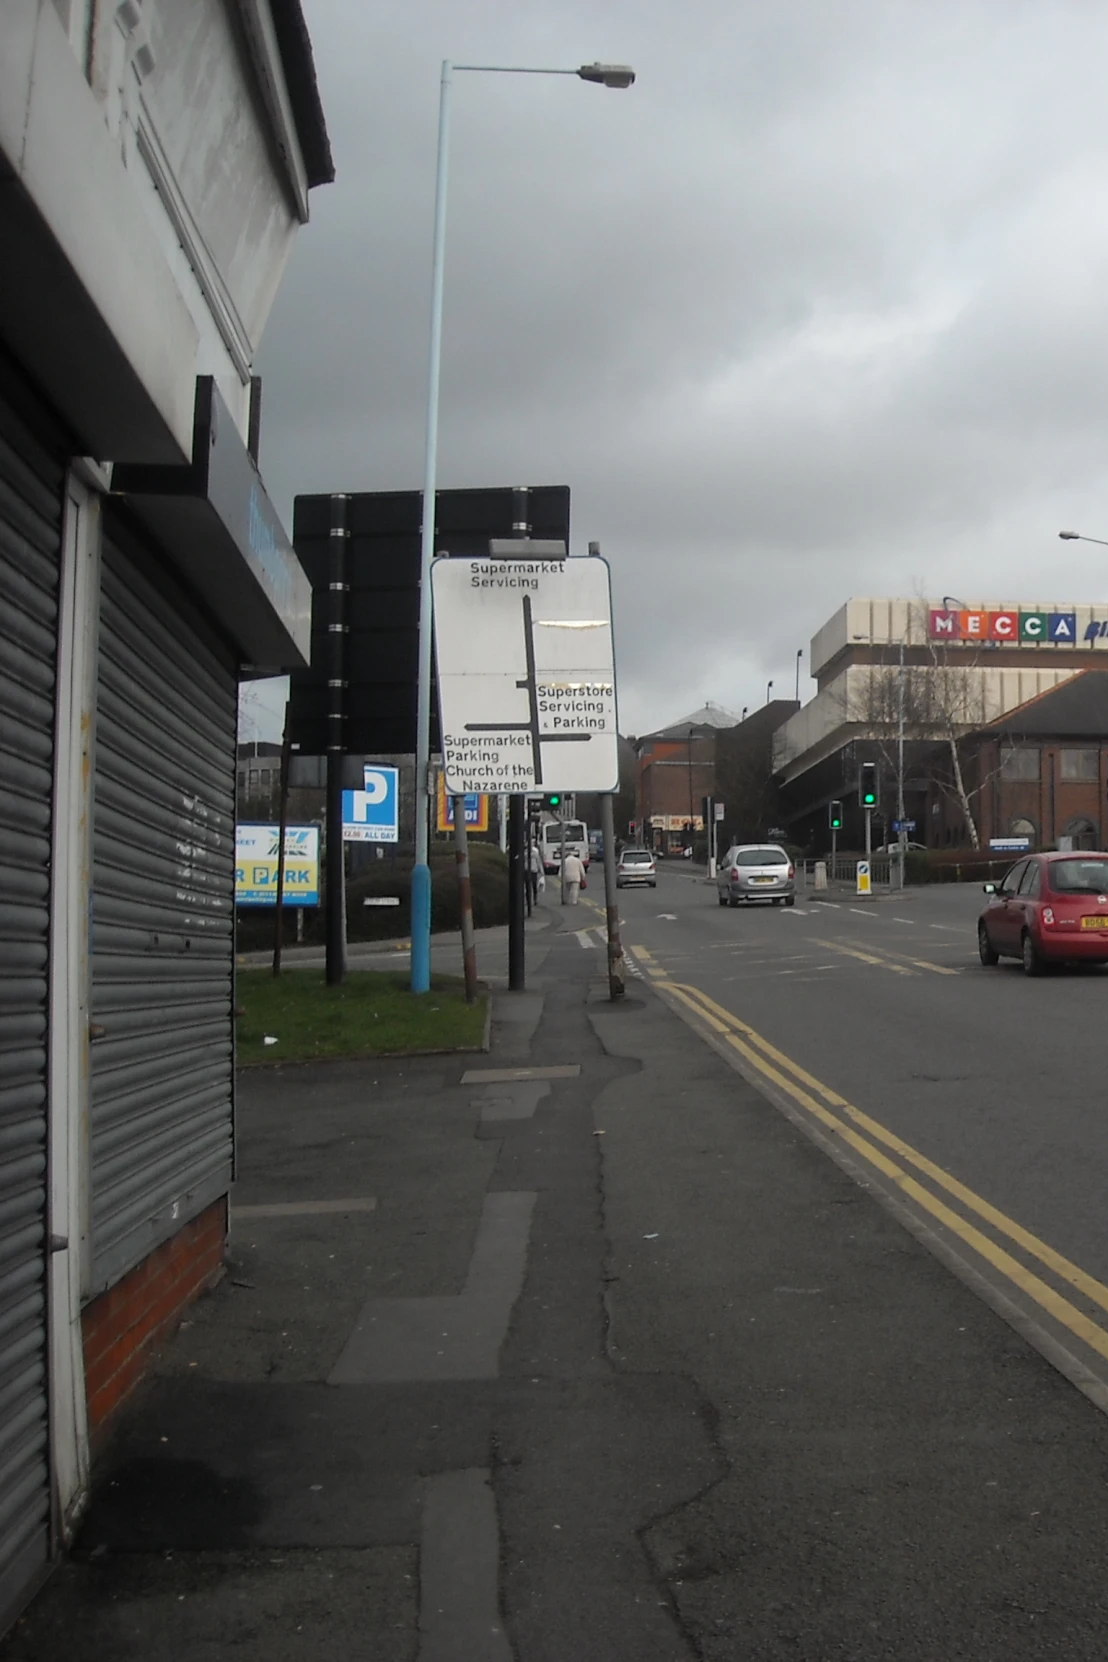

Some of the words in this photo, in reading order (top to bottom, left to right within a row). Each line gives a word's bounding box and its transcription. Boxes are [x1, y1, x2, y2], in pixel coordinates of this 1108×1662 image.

[471, 562, 565, 575] Supermarket
[471, 577, 539, 590] Servicing
[933, 614, 1072, 638] MECCA
[538, 686, 613, 699] Superstore
[539, 700, 604, 713] Servicing
[553, 717, 606, 730] Parking
[444, 735, 531, 748] Supermarket
[446, 750, 500, 763] Parking
[446, 765, 495, 776] Church
[496, 764, 510, 776] of
[513, 764, 534, 776] the
[462, 780, 528, 791] Nazarene
[353, 771, 388, 822] P
